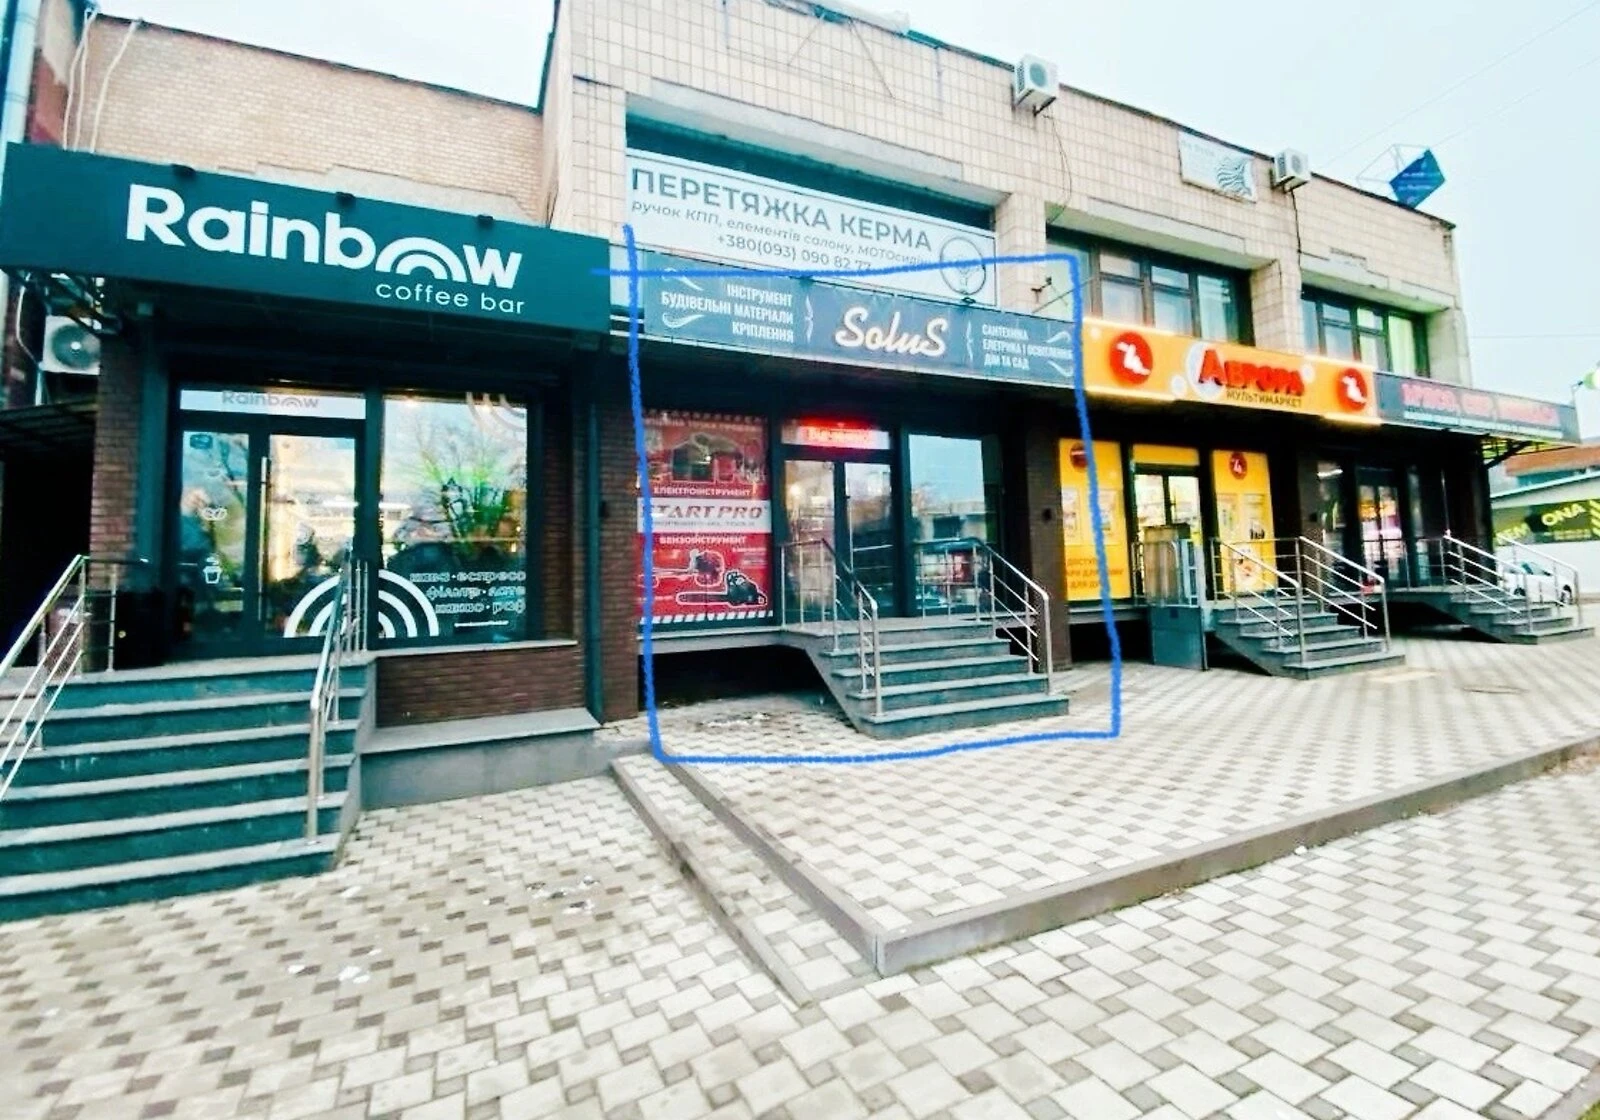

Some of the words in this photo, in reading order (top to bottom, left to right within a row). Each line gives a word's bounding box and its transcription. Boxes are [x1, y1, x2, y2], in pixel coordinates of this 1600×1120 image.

[631, 200, 681, 217] ручок
[686, 208, 722, 227] КПП,
[726, 218, 800, 242] елементів
[632, 168, 831, 231] ПЕРЕТЯЖКА
[840, 212, 932, 252] КЕРМА
[126, 183, 523, 289] Rainbow
[718, 234, 797, 263] +380(093)
[802, 249, 829, 266] 090
[834, 256, 851, 269] 82
[375, 283, 469, 308] coffee
[480, 292, 526, 315] bar
[660, 290, 732, 315] БУДІВЕЛЬНІ
[733, 303, 794, 325] МАТЕРІАЛИ
[726, 283, 793, 307] ІНСТРУМЕНТ
[731, 321, 794, 344] КРІПЛЕННЯ
[718, 504, 763, 520] PRO
